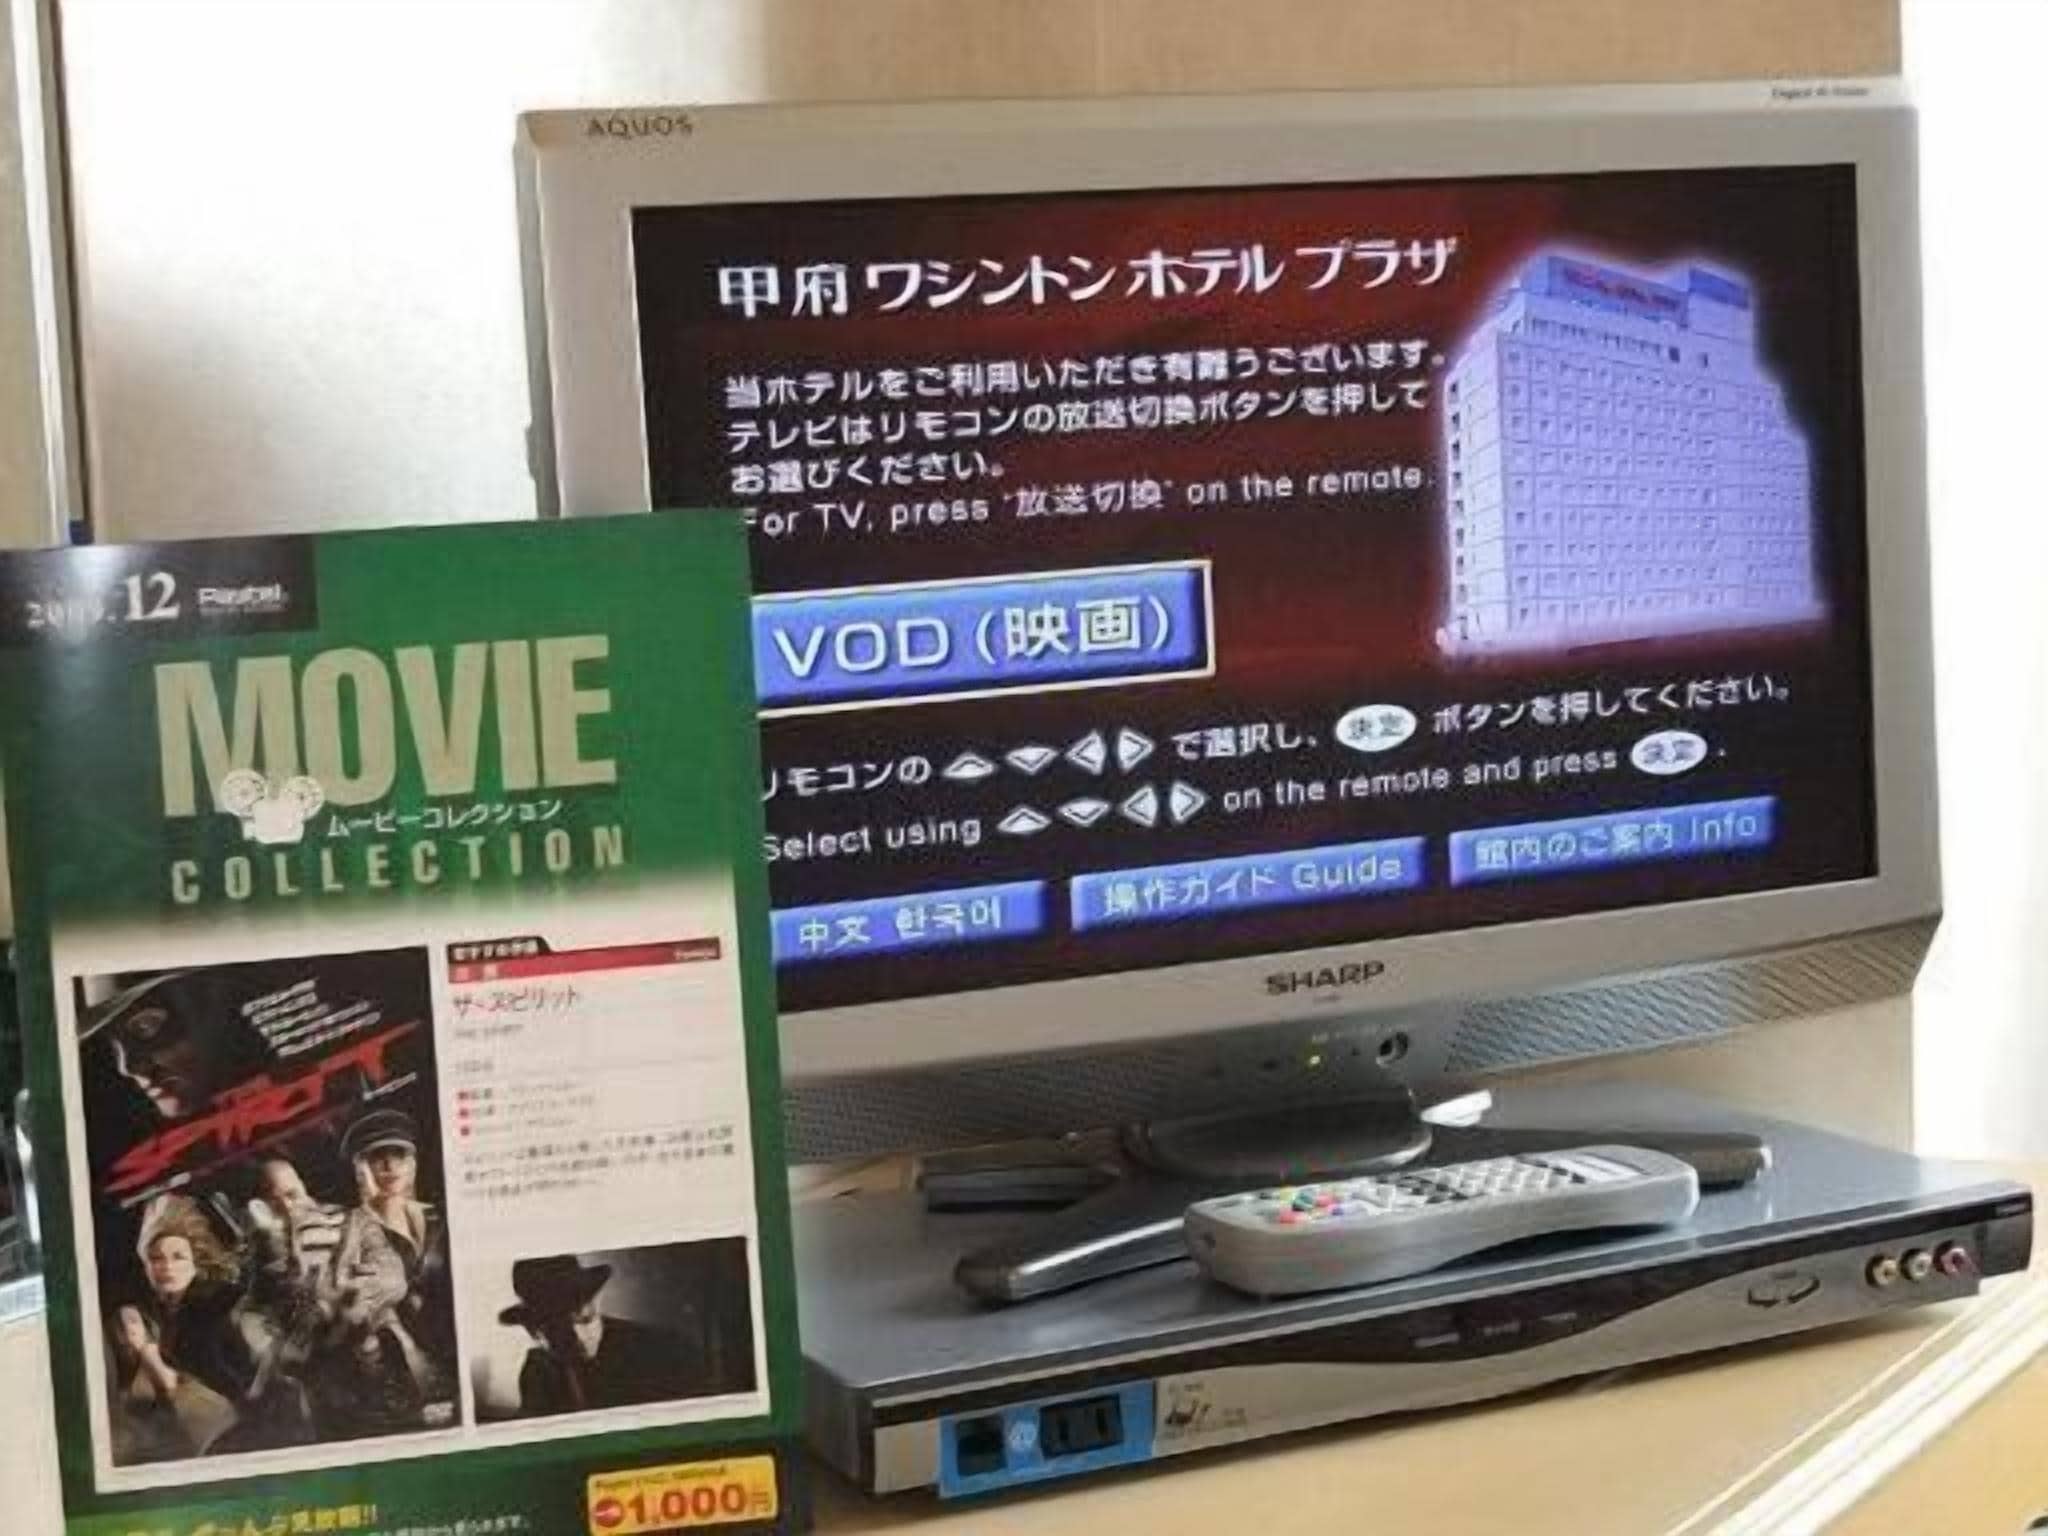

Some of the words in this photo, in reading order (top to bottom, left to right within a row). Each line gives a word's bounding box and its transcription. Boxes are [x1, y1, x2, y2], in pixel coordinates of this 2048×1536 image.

[586, 114, 694, 140] AQUOS
[717, 263, 848, 319] 甲府
[866, 254, 1116, 310] ワシントン
[1125, 246, 1285, 300] ホテル
[1297, 235, 1456, 290] プラザ
[890, 499, 989, 533] press
[1187, 480, 1228, 506] on
[1240, 473, 1294, 501] the
[124, 570, 181, 622] 12
[773, 617, 951, 678] VOD
[153, 634, 619, 819] MOVIE
[327, 798, 562, 837] ムービーコレクション
[885, 817, 983, 849] using
[1223, 777, 1262, 812] on
[1274, 770, 1326, 805] the
[1338, 762, 1450, 798] remote
[1462, 752, 1521, 785] and
[1532, 749, 1619, 783] press
[1687, 810, 1758, 843] Info
[170, 823, 625, 905] COLLECTION
[1292, 853, 1404, 890] Guide
[1265, 960, 1386, 996] SHARP
